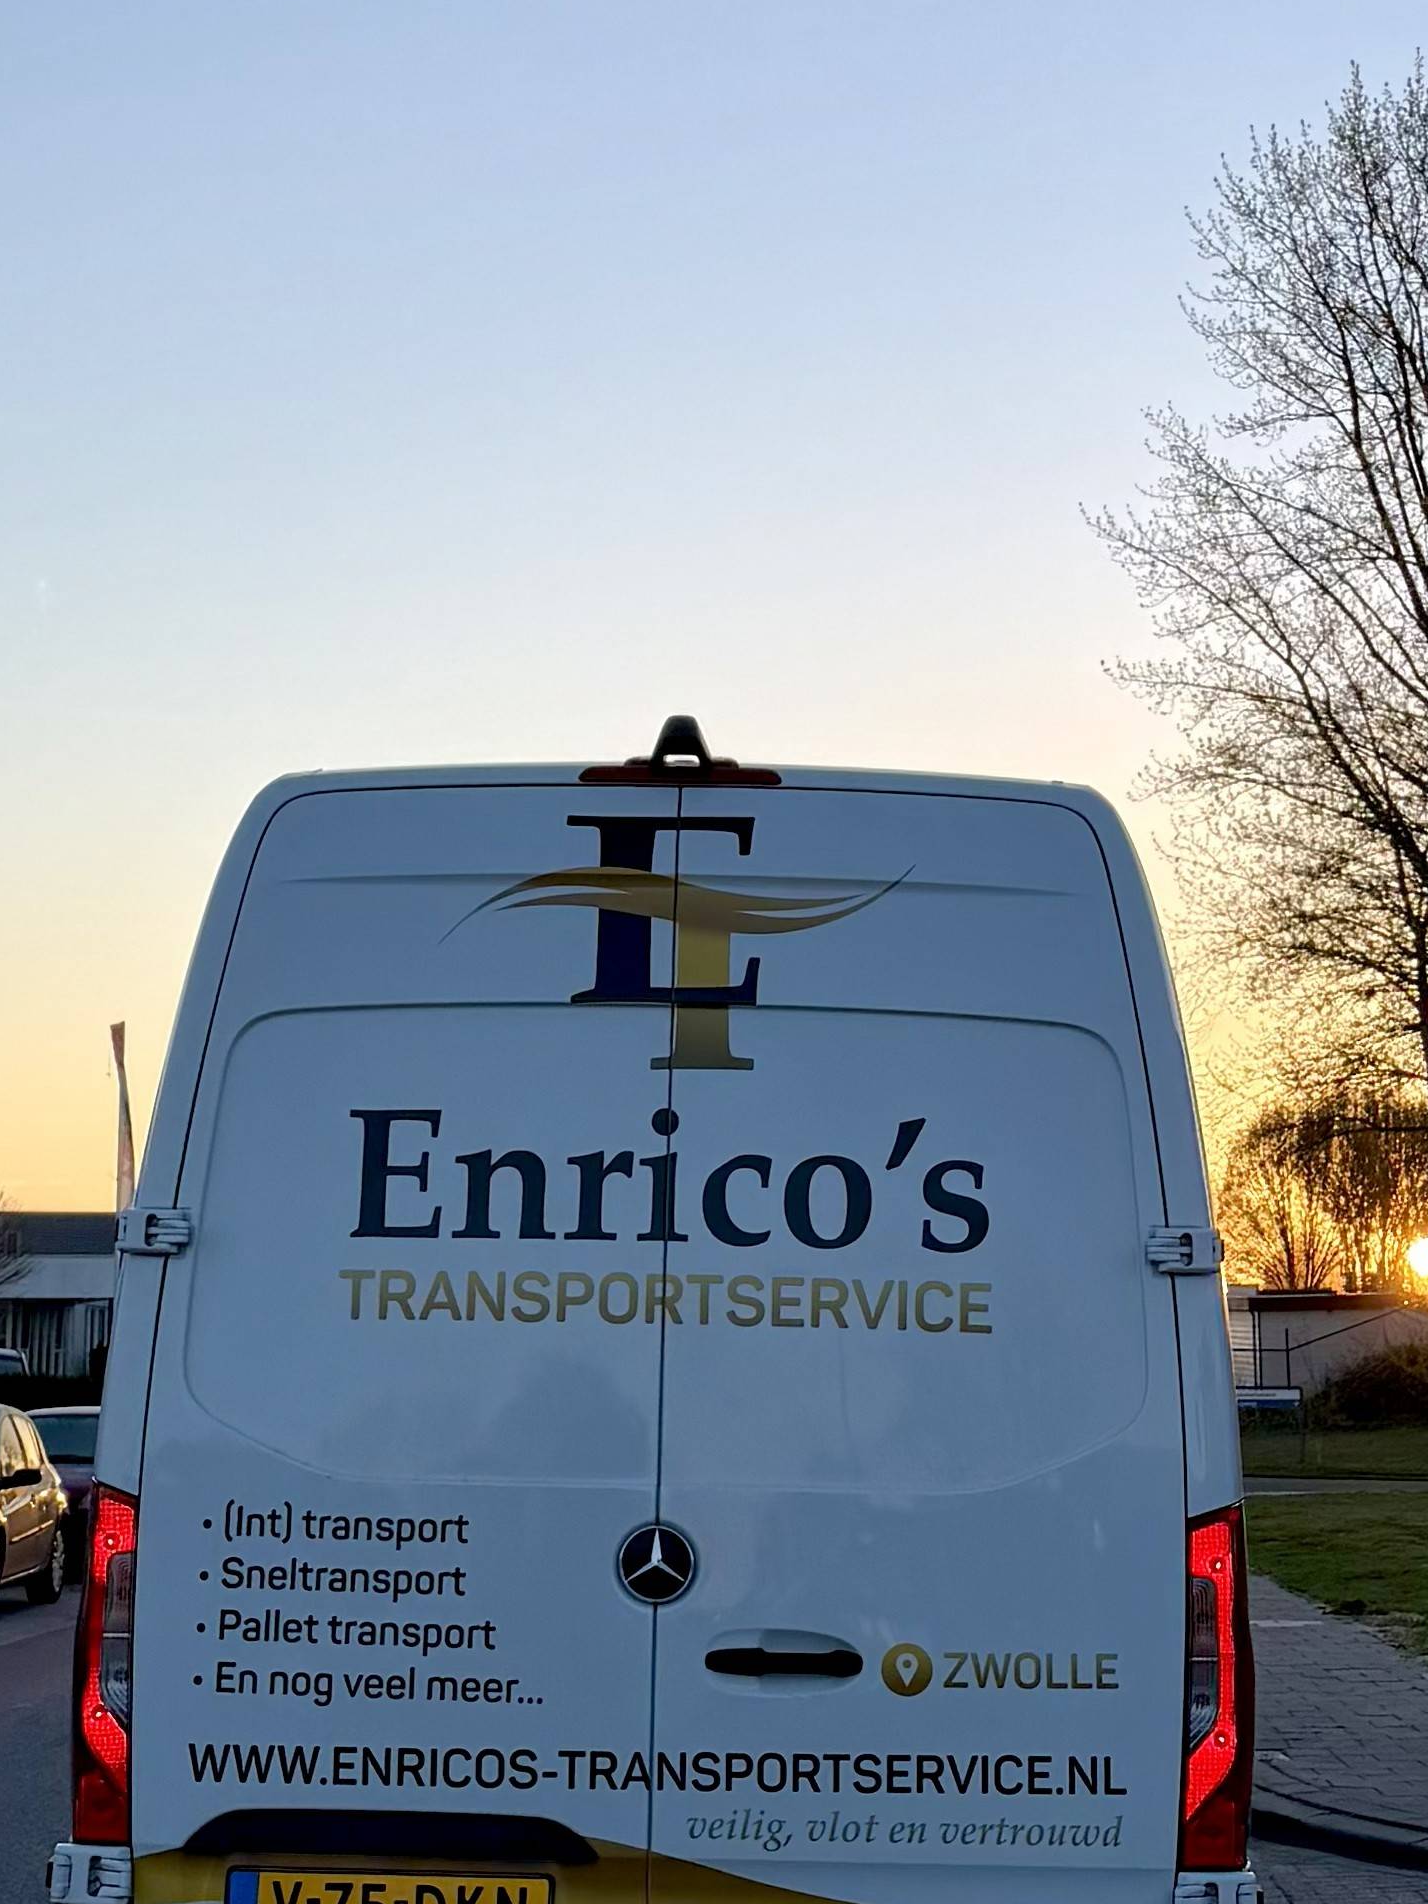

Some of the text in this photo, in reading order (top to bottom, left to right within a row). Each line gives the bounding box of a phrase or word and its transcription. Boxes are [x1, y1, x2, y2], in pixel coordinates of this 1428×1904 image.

[348, 1107, 993, 1255] Enrico's
[339, 1268, 994, 1336] TRANSPORTSERVICE
[224, 1498, 470, 1551] (Int) transport
[221, 1556, 467, 1603] Sneltransport
[218, 1609, 497, 1657] Pallet transport
[215, 1661, 544, 1707] En nog veel meer...
[943, 1652, 1120, 1690] ZWOLLE
[187, 1742, 1129, 1797] WWW.ENRICOS-TRANSPORTSERVICE.NL
[686, 1808, 1125, 1853] veilig, vlot en vertrouwd
